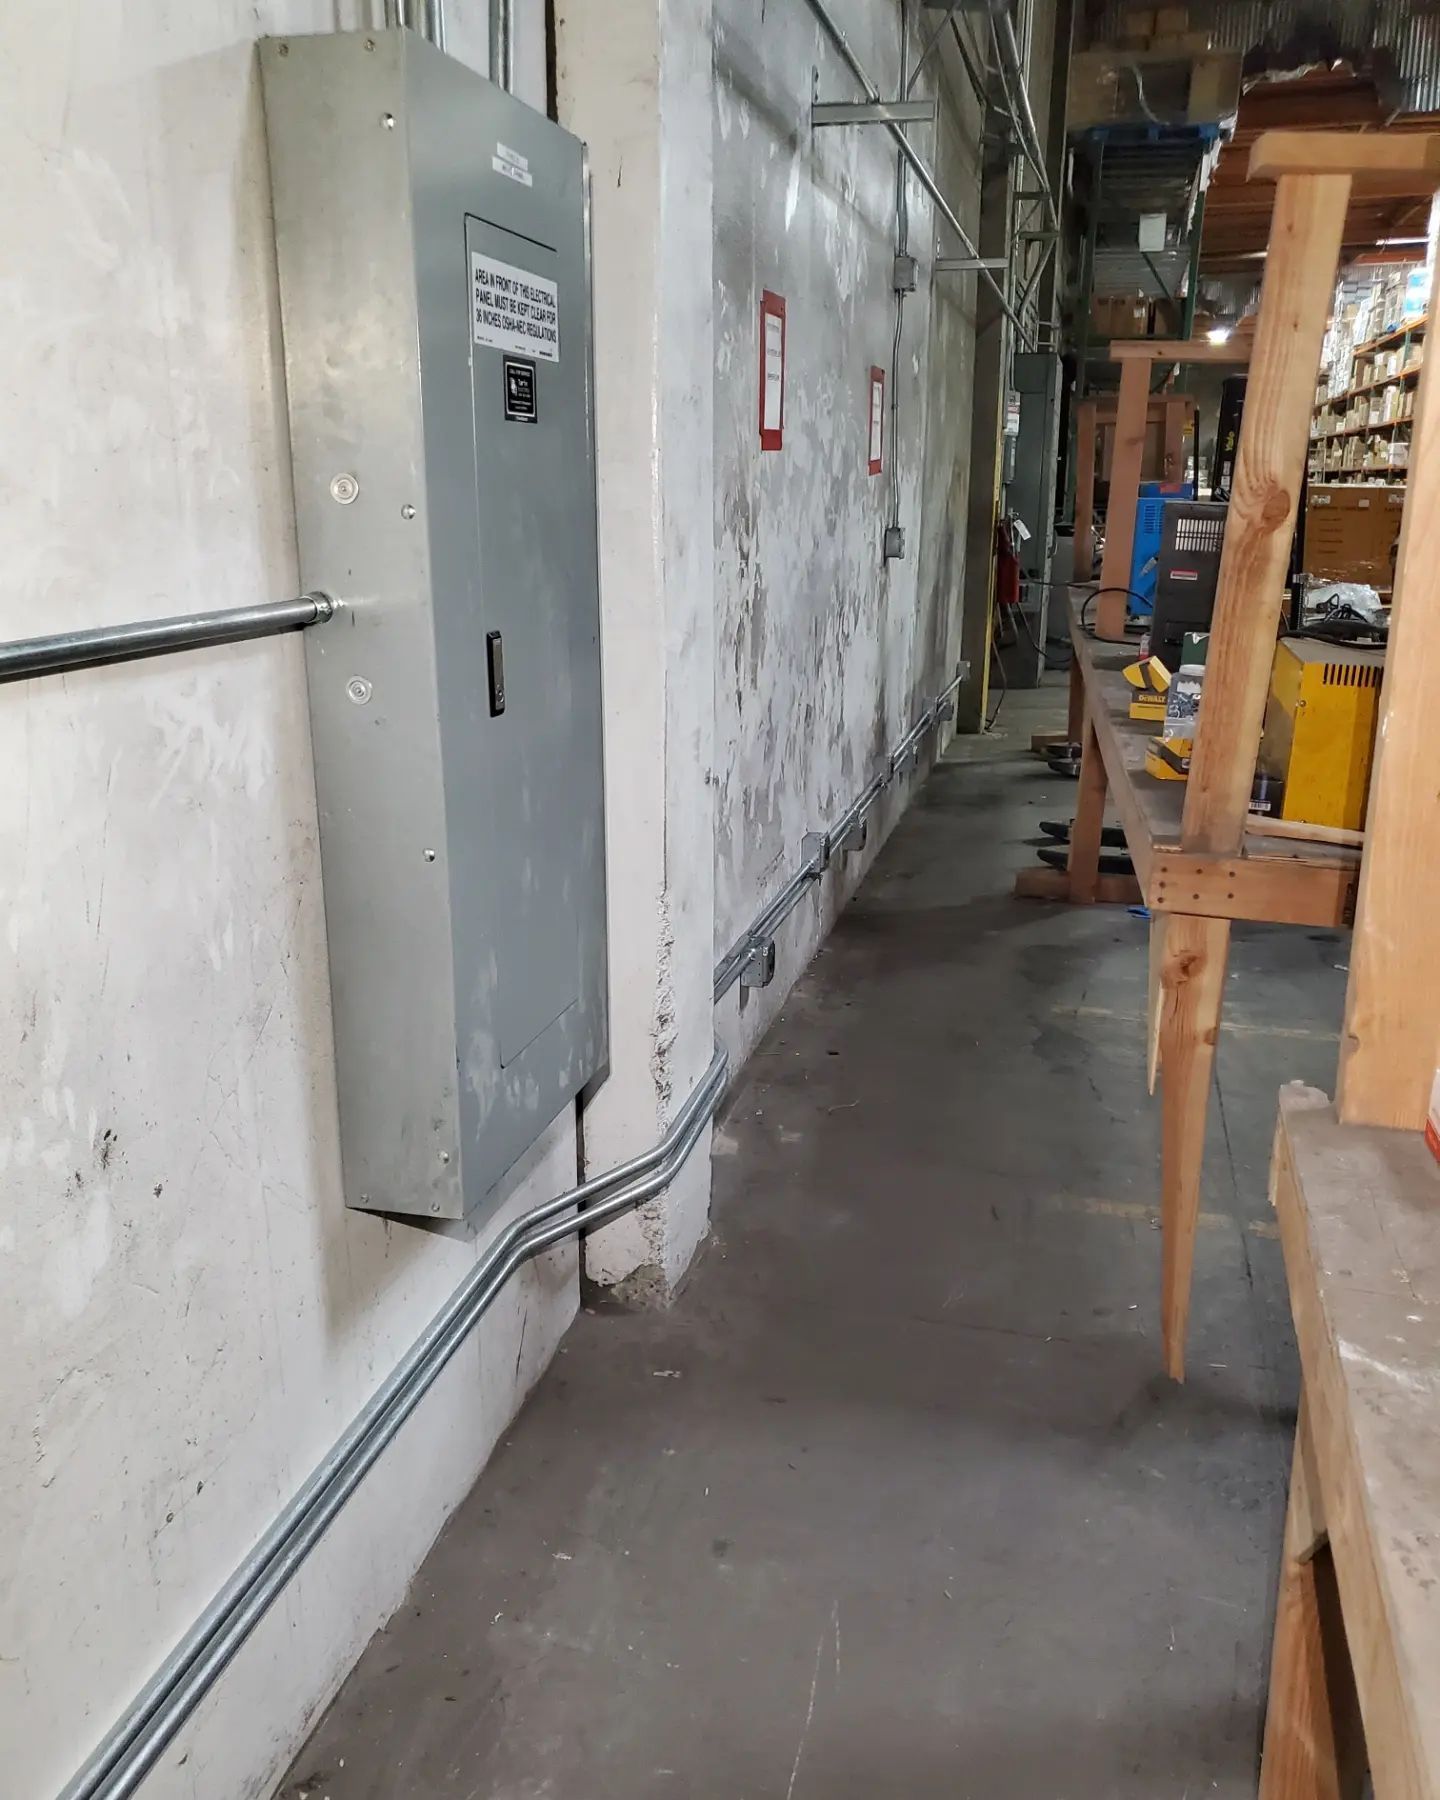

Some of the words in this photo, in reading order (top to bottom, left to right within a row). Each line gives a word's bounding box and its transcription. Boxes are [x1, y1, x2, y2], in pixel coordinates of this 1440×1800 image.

[475, 268, 489, 285] AREA
[490, 274, 494, 288] IN
[496, 275, 512, 293] FRONT
[512, 281, 518, 296] OF
[520, 283, 530, 299] THIS
[530, 287, 556, 308] ELECTRICAL
[476, 288, 494, 307] PANEL
[494, 293, 508, 311] MUST
[510, 299, 516, 314] BE
[518, 302, 530, 317] KEPT
[530, 306, 546, 322] CLEAR
[547, 311, 556, 325] FOR
[476, 308, 482, 323] 36
[483, 310, 501, 328] INCHES
[502, 315, 526, 334] OSHA-NEC
[527, 322, 556, 343] REGULATIONS
